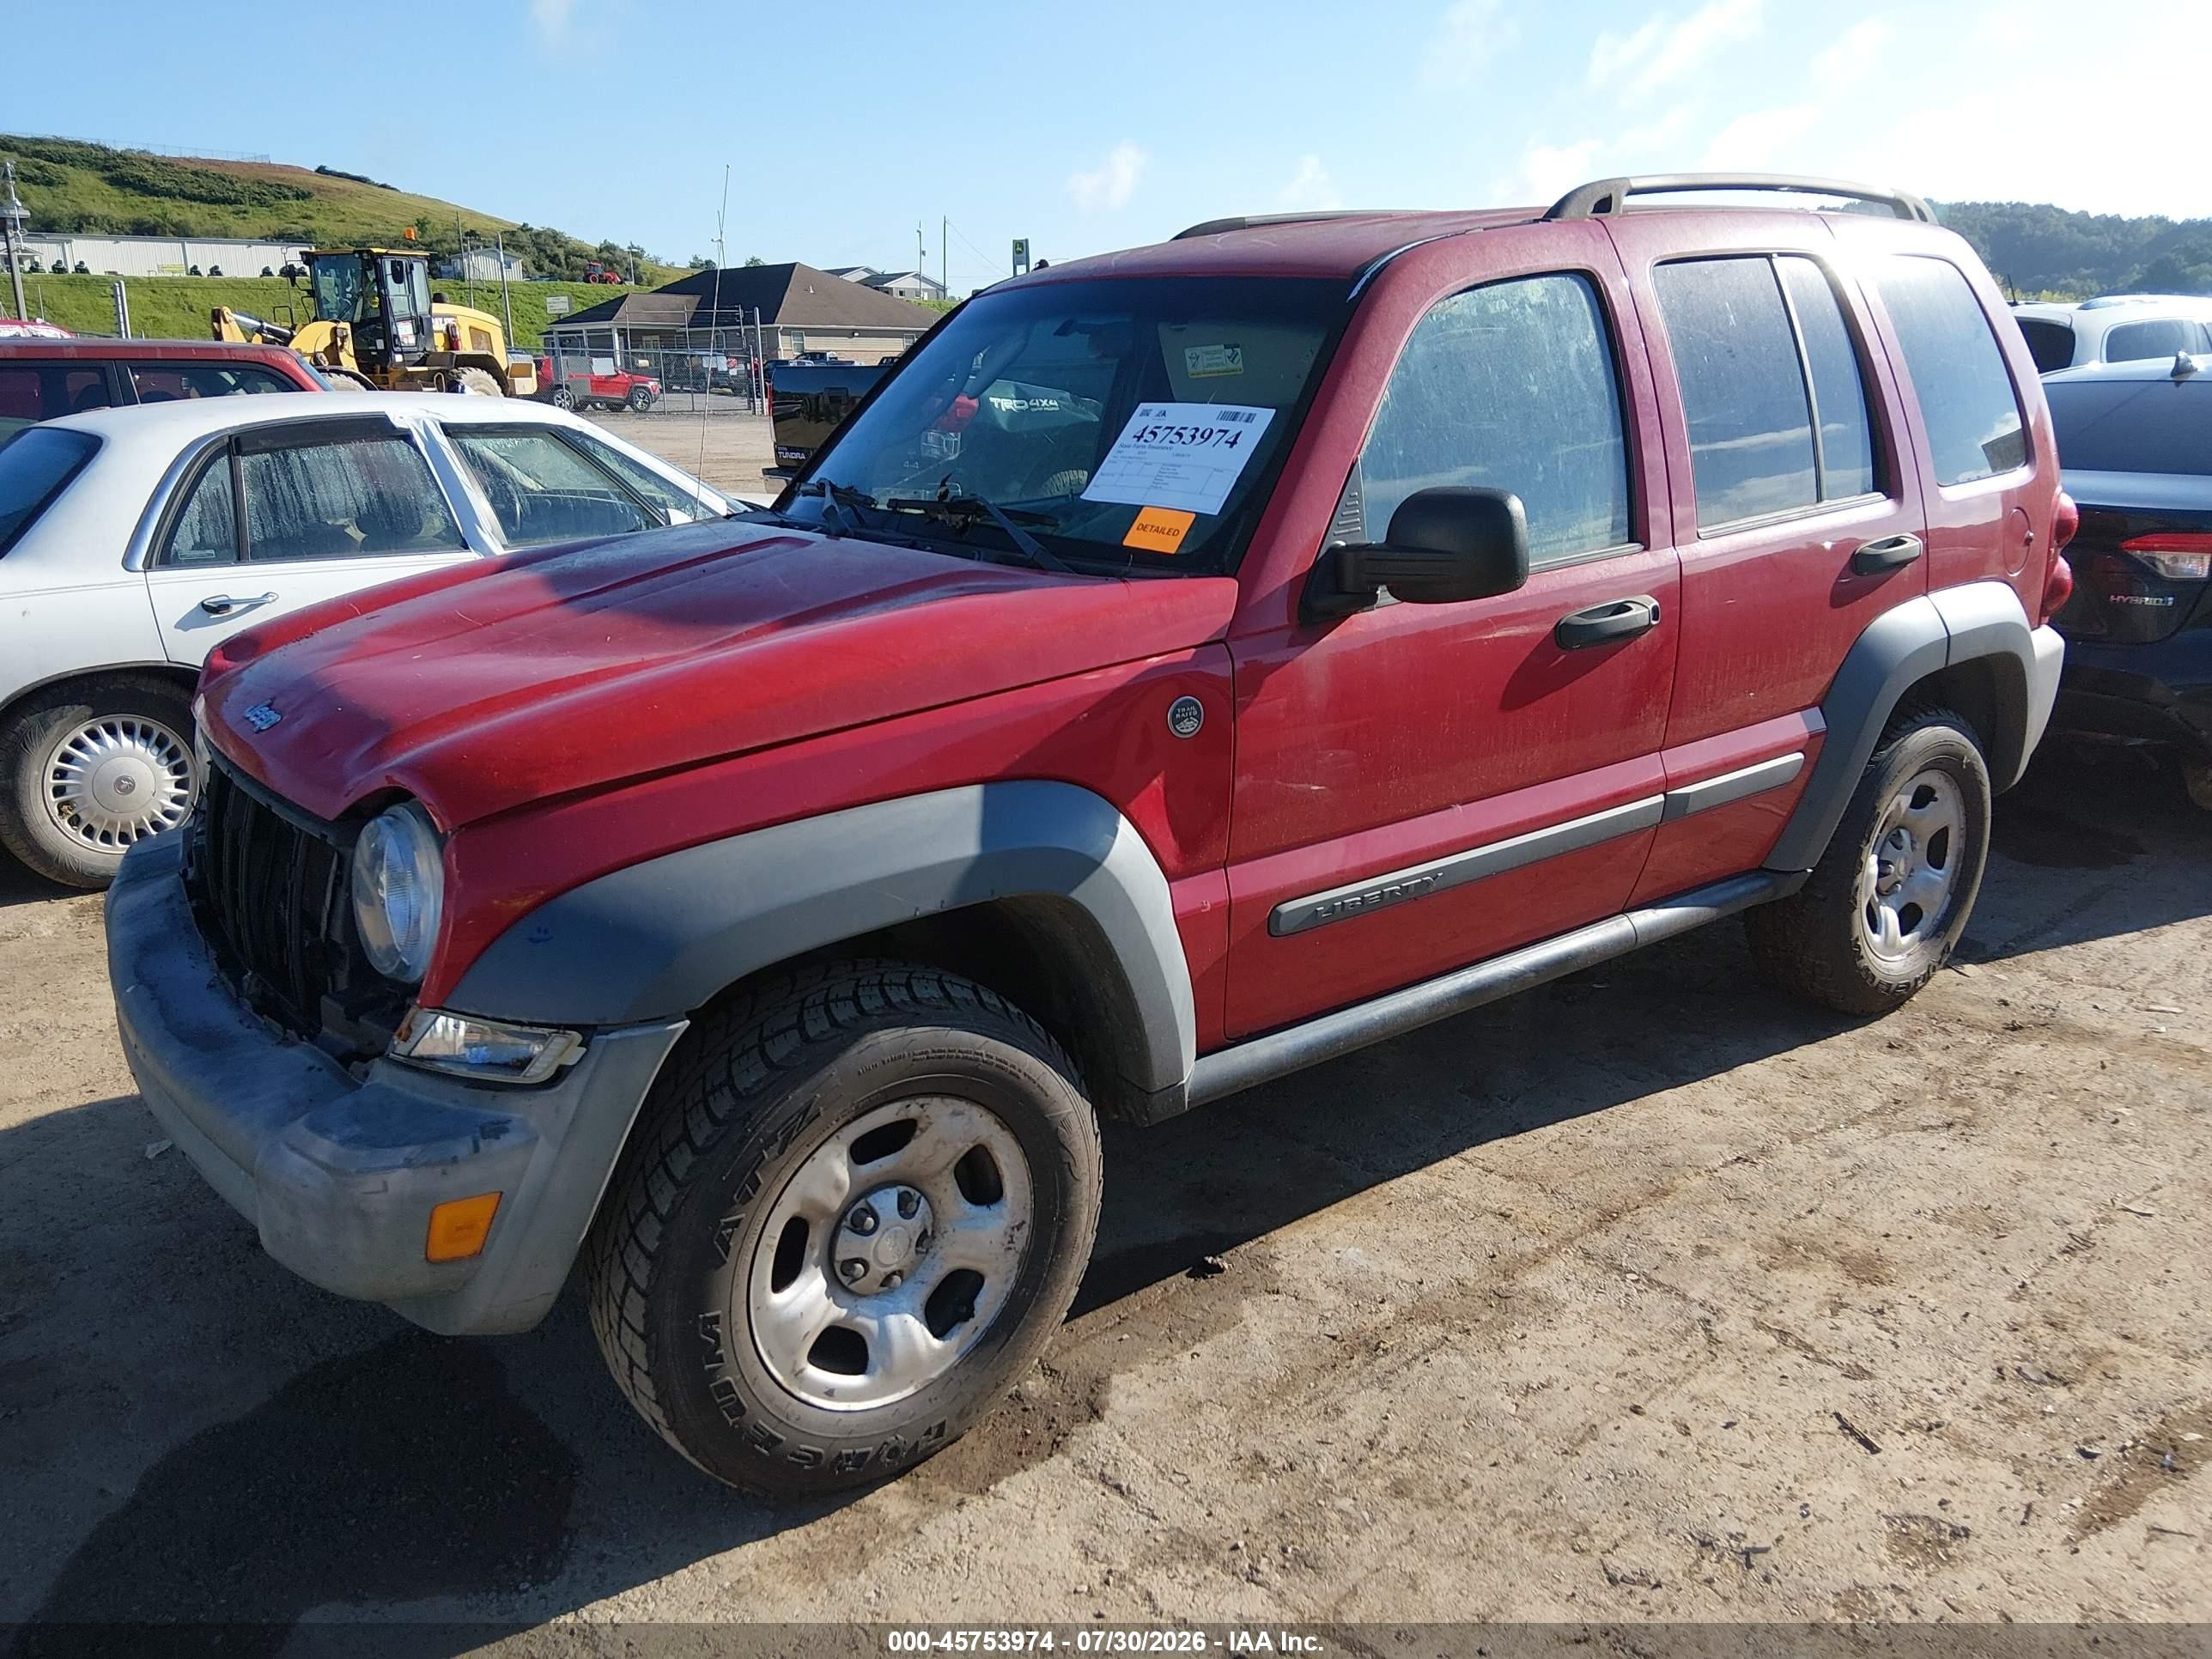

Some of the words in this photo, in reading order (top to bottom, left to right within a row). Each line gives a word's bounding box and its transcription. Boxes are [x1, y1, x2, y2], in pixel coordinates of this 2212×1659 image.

[988, 397, 1029, 412] TRD
[1133, 423, 1243, 448] 45753974
[777, 451, 806, 459] TUNDRA
[1136, 522, 1181, 537] DETAILED
[2110, 594, 2165, 606] HYBRID
[1315, 872, 1444, 918] LIBERTY
[698, 1310, 947, 1476] FORCEUM
